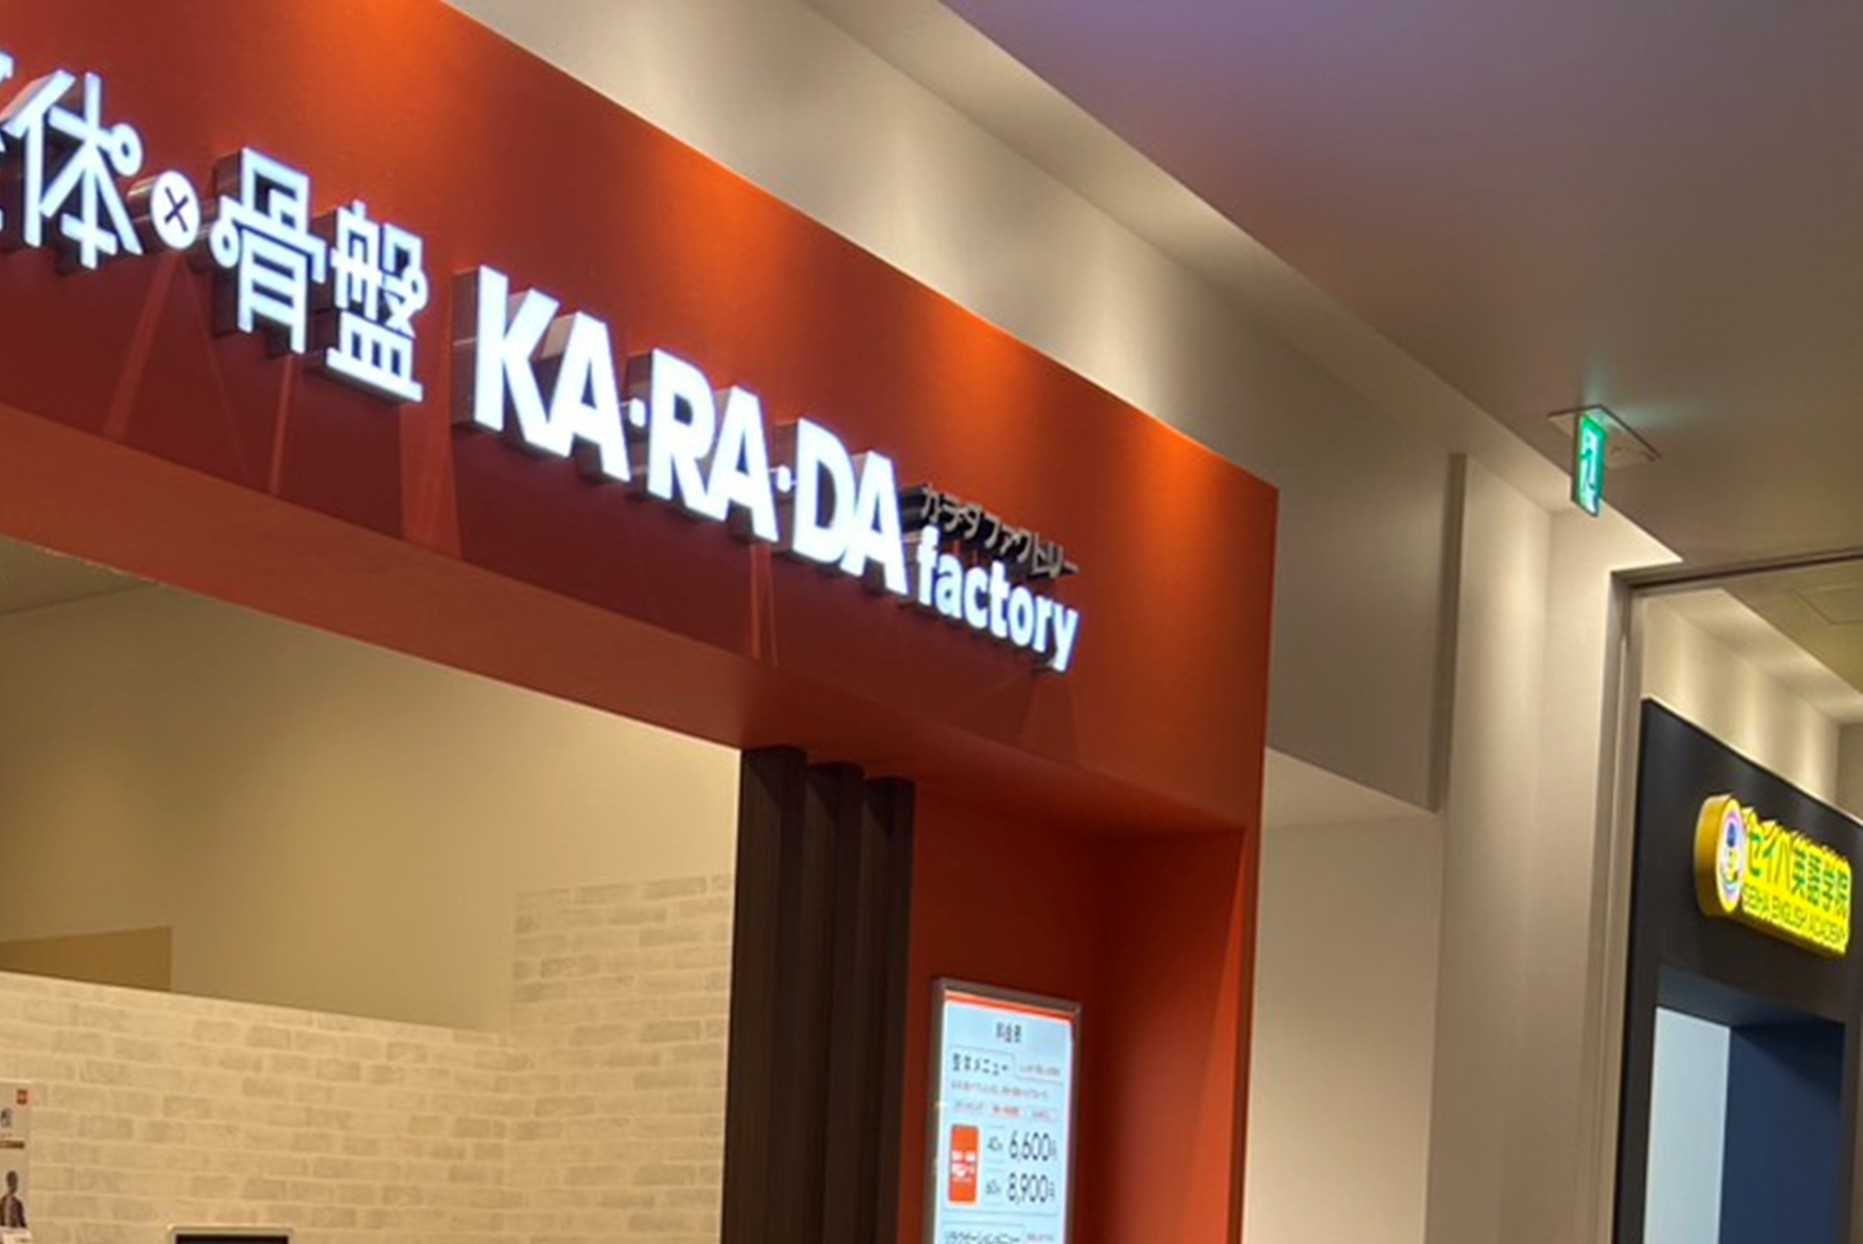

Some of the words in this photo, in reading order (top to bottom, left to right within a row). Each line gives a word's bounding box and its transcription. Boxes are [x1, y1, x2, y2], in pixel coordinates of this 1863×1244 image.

[921, 482, 1079, 579] カラダファクトリー
[916, 524, 1080, 672] factory
